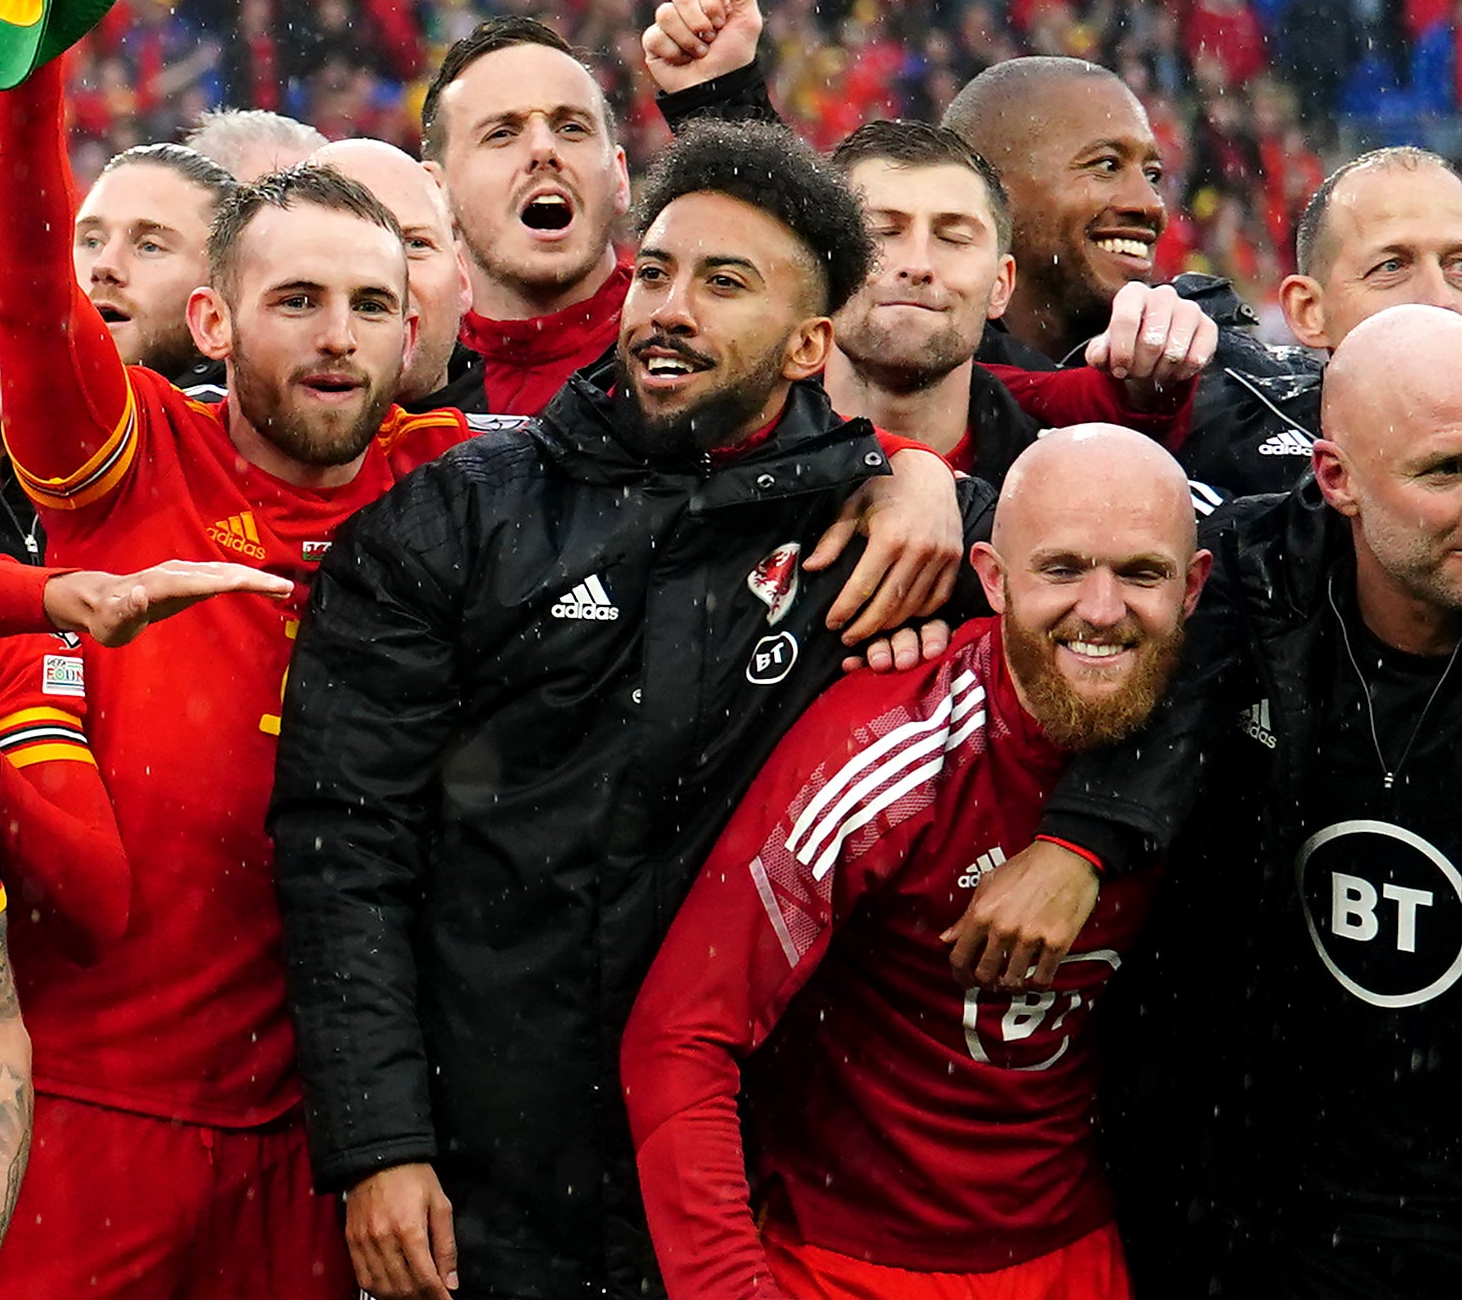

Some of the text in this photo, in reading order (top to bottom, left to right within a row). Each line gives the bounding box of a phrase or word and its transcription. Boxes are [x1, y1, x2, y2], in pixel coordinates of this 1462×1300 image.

[207, 527, 265, 560] adidas
[551, 602, 619, 621] adidas
[755, 642, 784, 673] BT
[1331, 871, 1434, 953] BT
